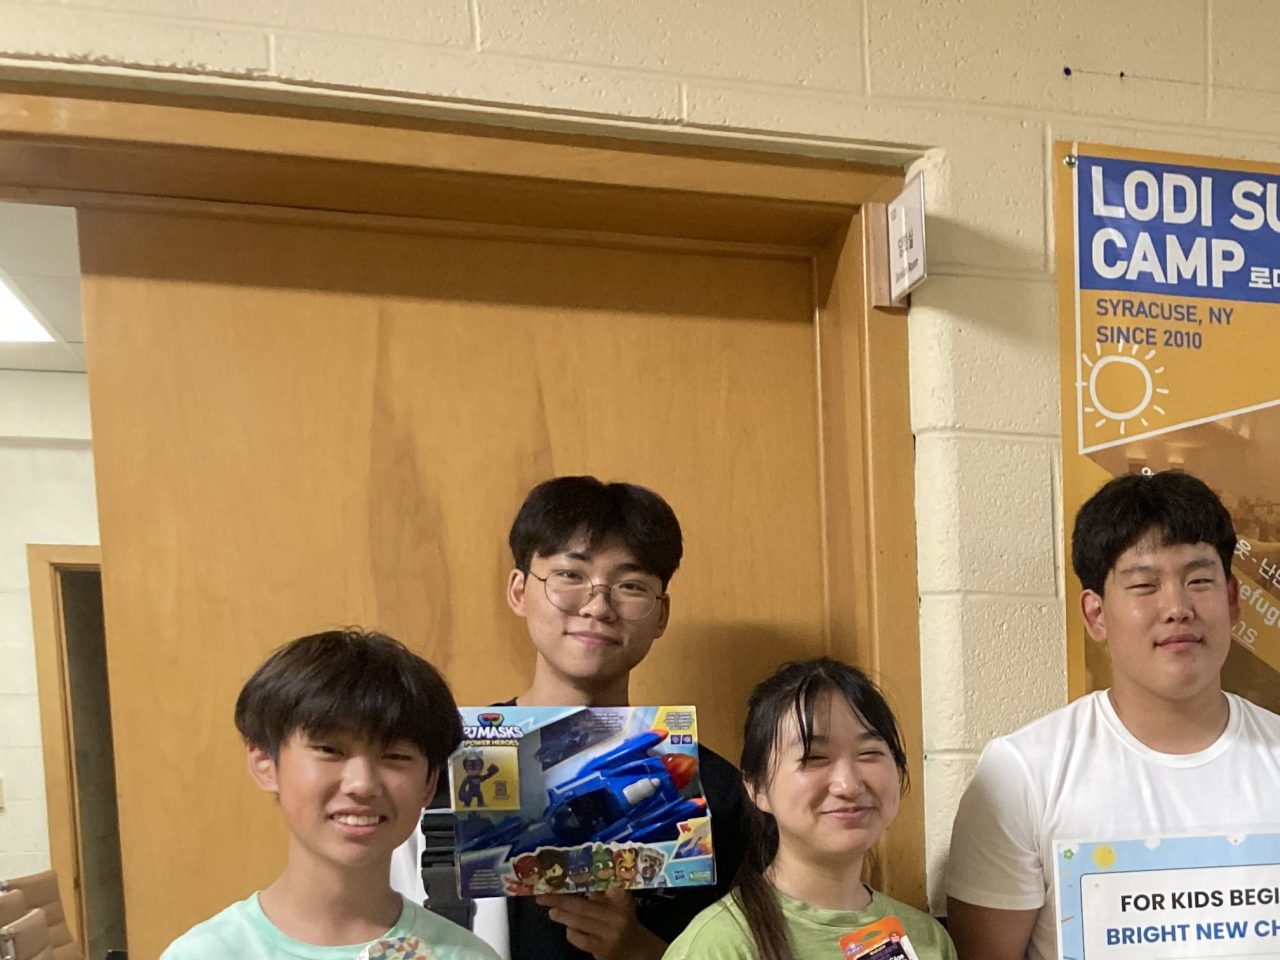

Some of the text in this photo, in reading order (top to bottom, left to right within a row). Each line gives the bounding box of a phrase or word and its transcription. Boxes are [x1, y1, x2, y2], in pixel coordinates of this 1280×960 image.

[1091, 165, 1212, 226] LODI
[1091, 228, 1245, 288] CAMP
[1096, 299, 1234, 326] SYRACUSE, NY
[1096, 326, 1202, 349] SINCE 2010
[1234, 539, 1252, 561] 웃
[477, 726, 524, 739] MASKS
[1121, 894, 1166, 912] FOR
[1171, 890, 1224, 909] KIDS
[1106, 924, 1190, 945] BRIGHT
[1196, 921, 1248, 941] NEW
